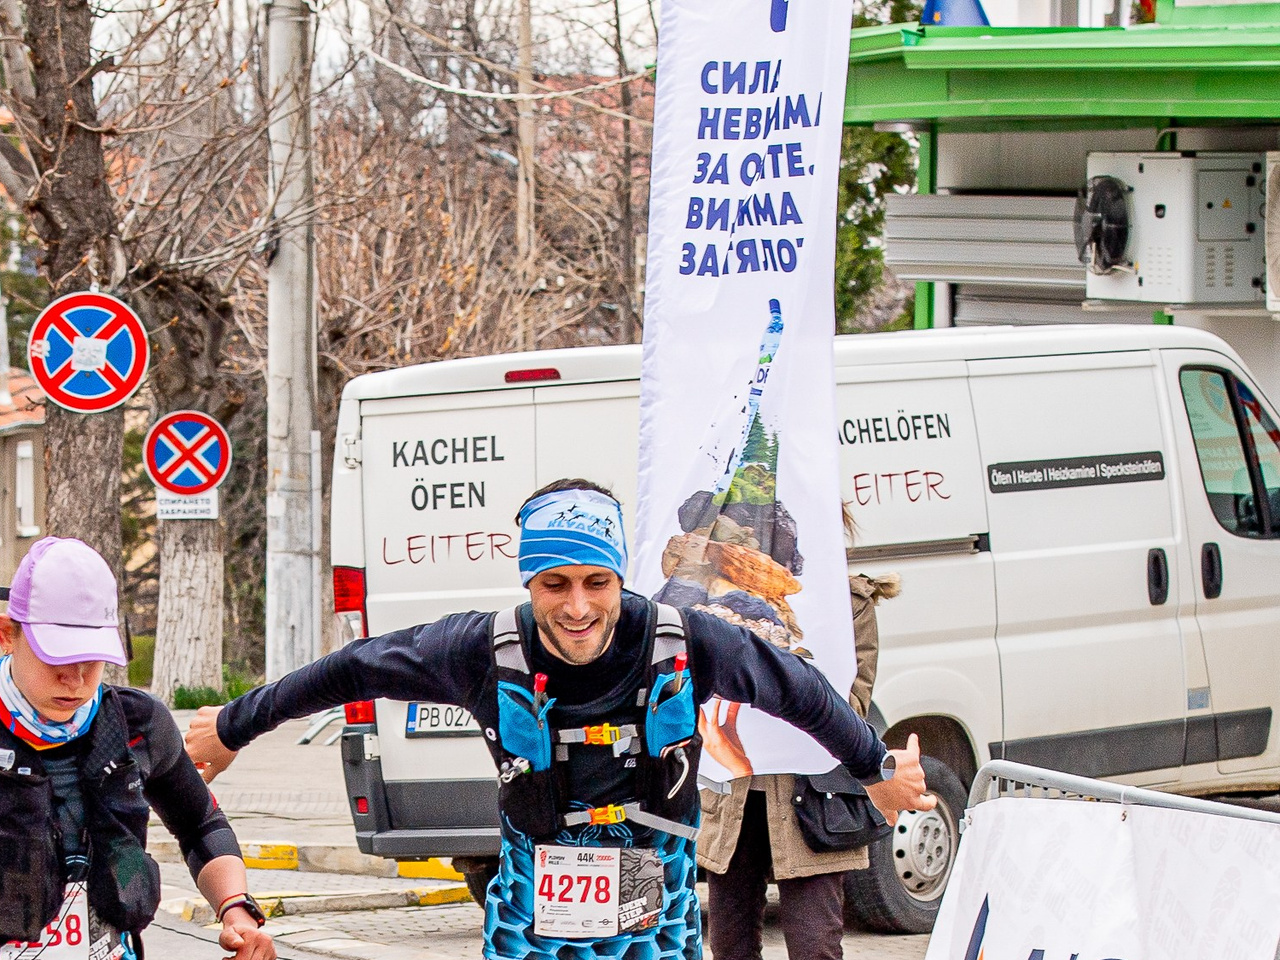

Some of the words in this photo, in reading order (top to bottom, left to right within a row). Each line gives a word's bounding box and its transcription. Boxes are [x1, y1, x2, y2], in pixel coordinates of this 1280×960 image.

[692, 152, 730, 184] ЗА
[679, 242, 720, 277] ЗА
[391, 435, 505, 468] KACHEL
[843, 469, 952, 506] EITER
[991, 469, 1012, 486] Öfen
[1017, 469, 1043, 483] Herde
[1048, 465, 1094, 481] Heizkamine
[1100, 459, 1162, 479] Specksteinöfen
[411, 478, 486, 511] ÖFEN
[382, 532, 518, 566] LEITER
[418, 706, 440, 728] PB
[577, 852, 595, 863] 44K
[538, 874, 610, 904] 4278
[6, 914, 82, 949] 58
